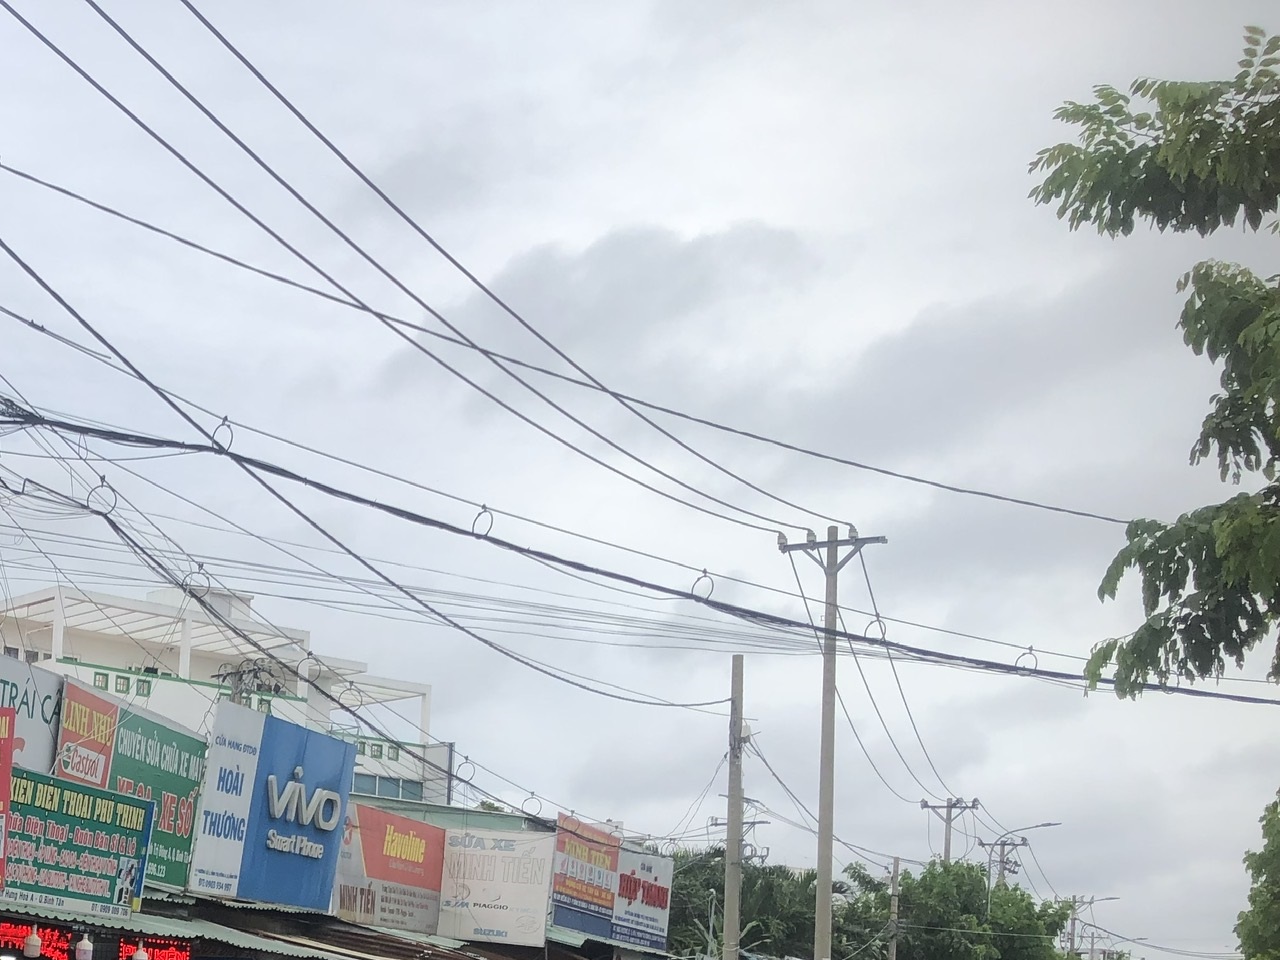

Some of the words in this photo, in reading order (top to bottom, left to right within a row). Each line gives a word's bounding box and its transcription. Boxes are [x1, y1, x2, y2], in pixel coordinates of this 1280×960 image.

[0, 678, 36, 719] TRÁI
[41, 687, 64, 725] CÂ
[70, 745, 99, 779] Castrol
[217, 765, 245, 797] HOÀI
[34, 779, 61, 817] ĐIỆN
[63, 789, 94, 825] THOẠI
[116, 803, 146, 835] THỊNH
[158, 791, 177, 834] XE
[176, 787, 199, 838] SỐ
[46, 820, 70, 846] Thoại
[203, 810, 246, 842] THƯƠNG
[448, 832, 486, 850] SỬA
[490, 838, 517, 852] XE
[383, 824, 426, 864] Havoline
[449, 852, 497, 882] MINH
[501, 847, 546, 885] TIẾN
[472, 902, 509, 911] PIAGGIO
[473, 927, 508, 938] SUZUKI
